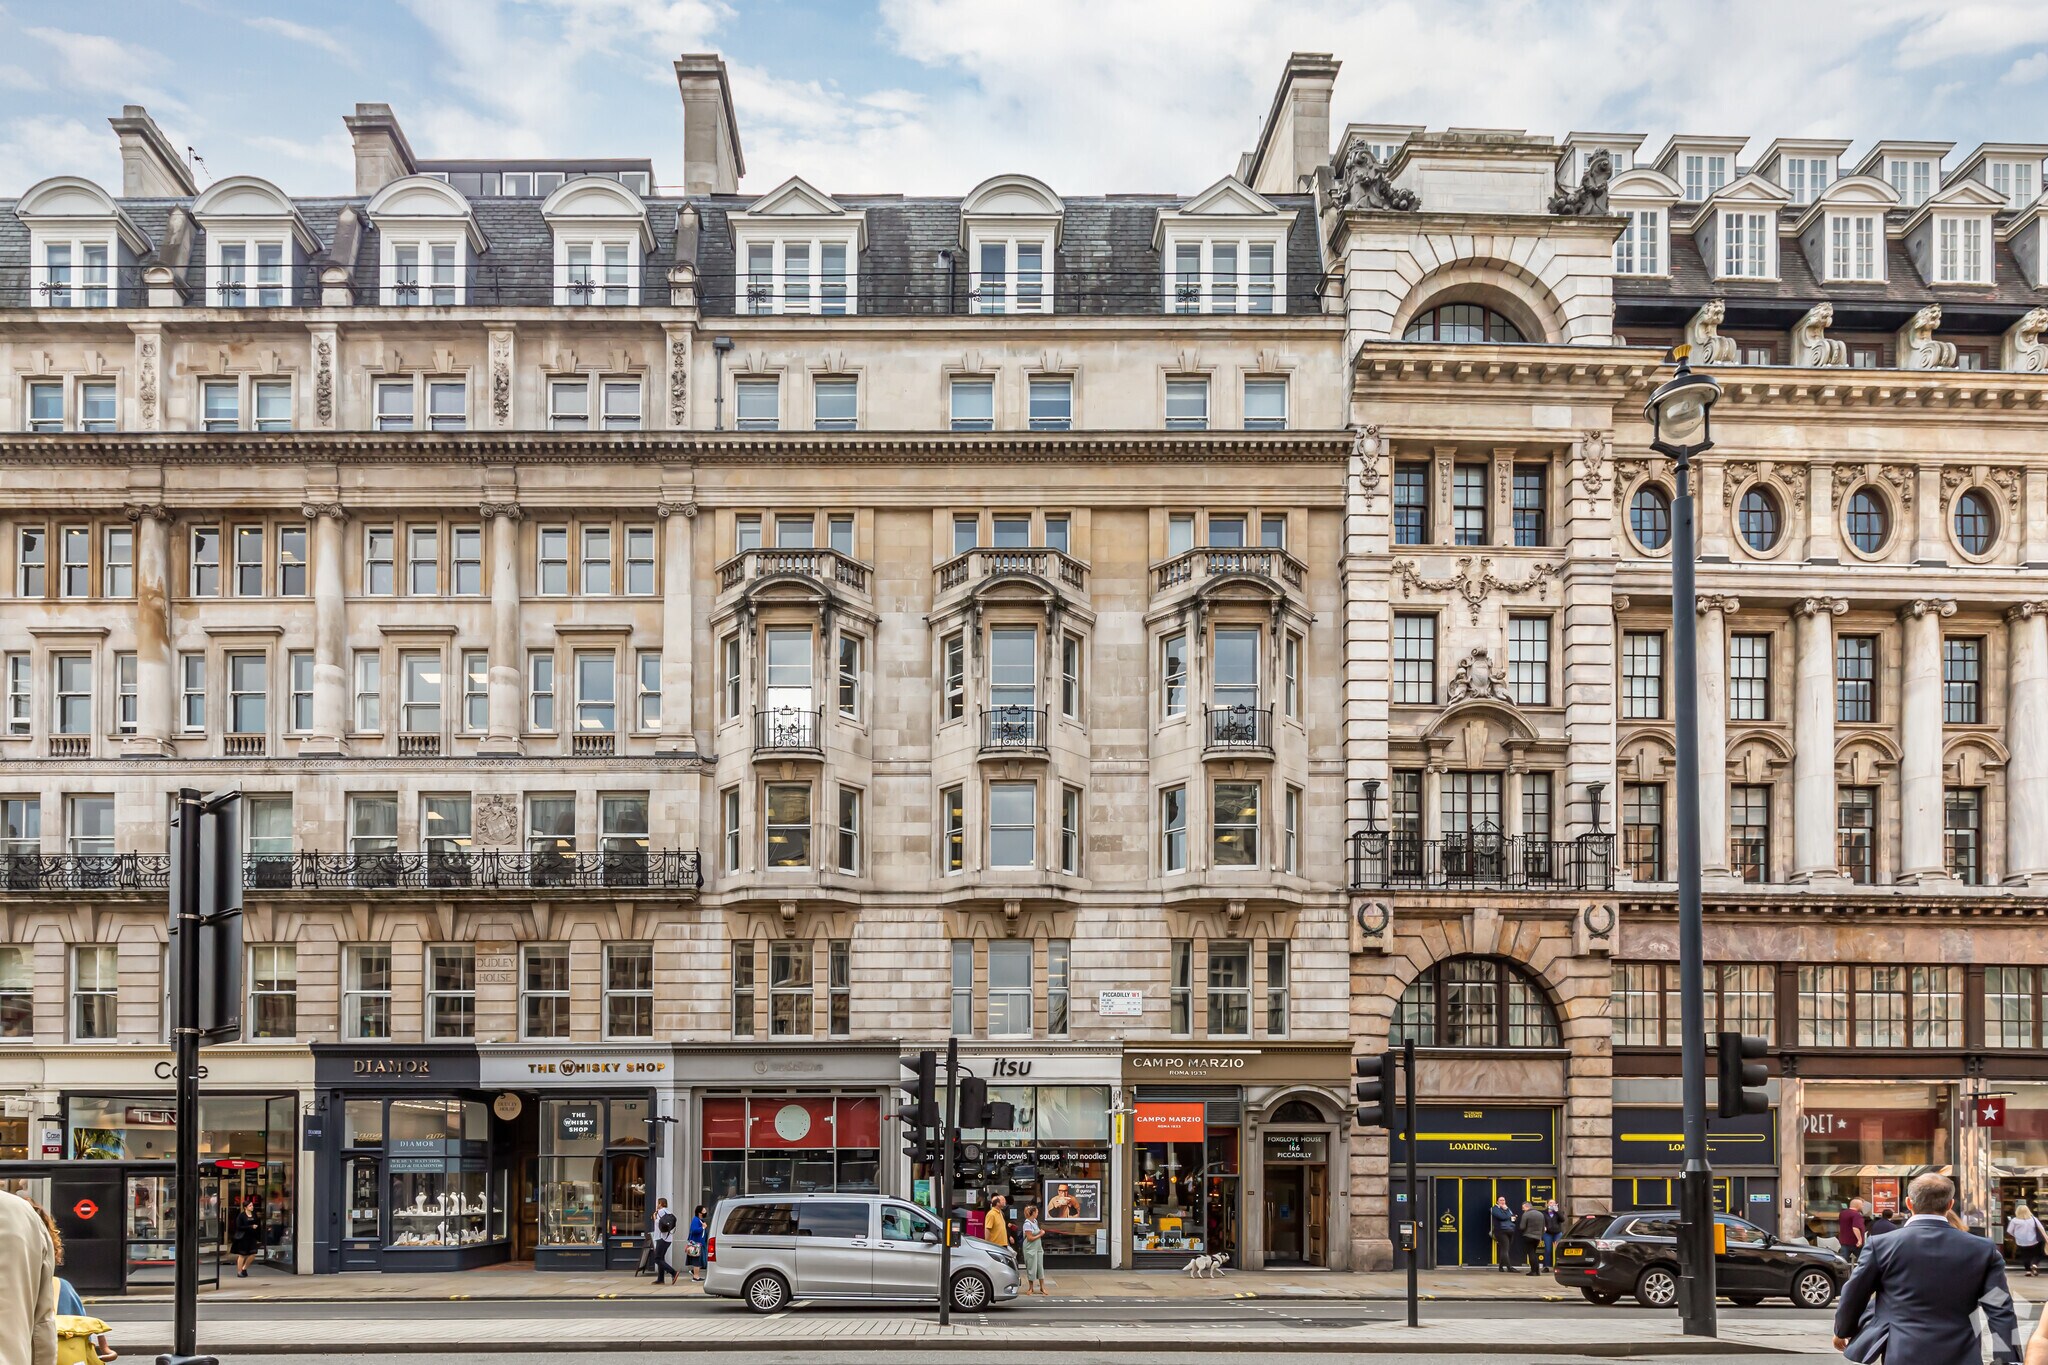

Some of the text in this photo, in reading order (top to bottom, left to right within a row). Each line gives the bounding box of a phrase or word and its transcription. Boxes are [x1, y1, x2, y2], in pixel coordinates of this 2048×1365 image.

[477, 958, 515, 967] DUDLEY
[480, 974, 511, 982] HOUSE
[353, 1060, 430, 1073] DIAMOR
[528, 1061, 665, 1075] THE WHISKY SHOP
[992, 1058, 1032, 1077] itsu
[1133, 1058, 1244, 1068] CAMPO MARZIO
[154, 1062, 208, 1079] Ce
[1803, 1114, 1833, 1134] PRET
[46, 1131, 61, 1139] Case
[1007, 1152, 1027, 1160] bowls
[1039, 1153, 1060, 1161] soups
